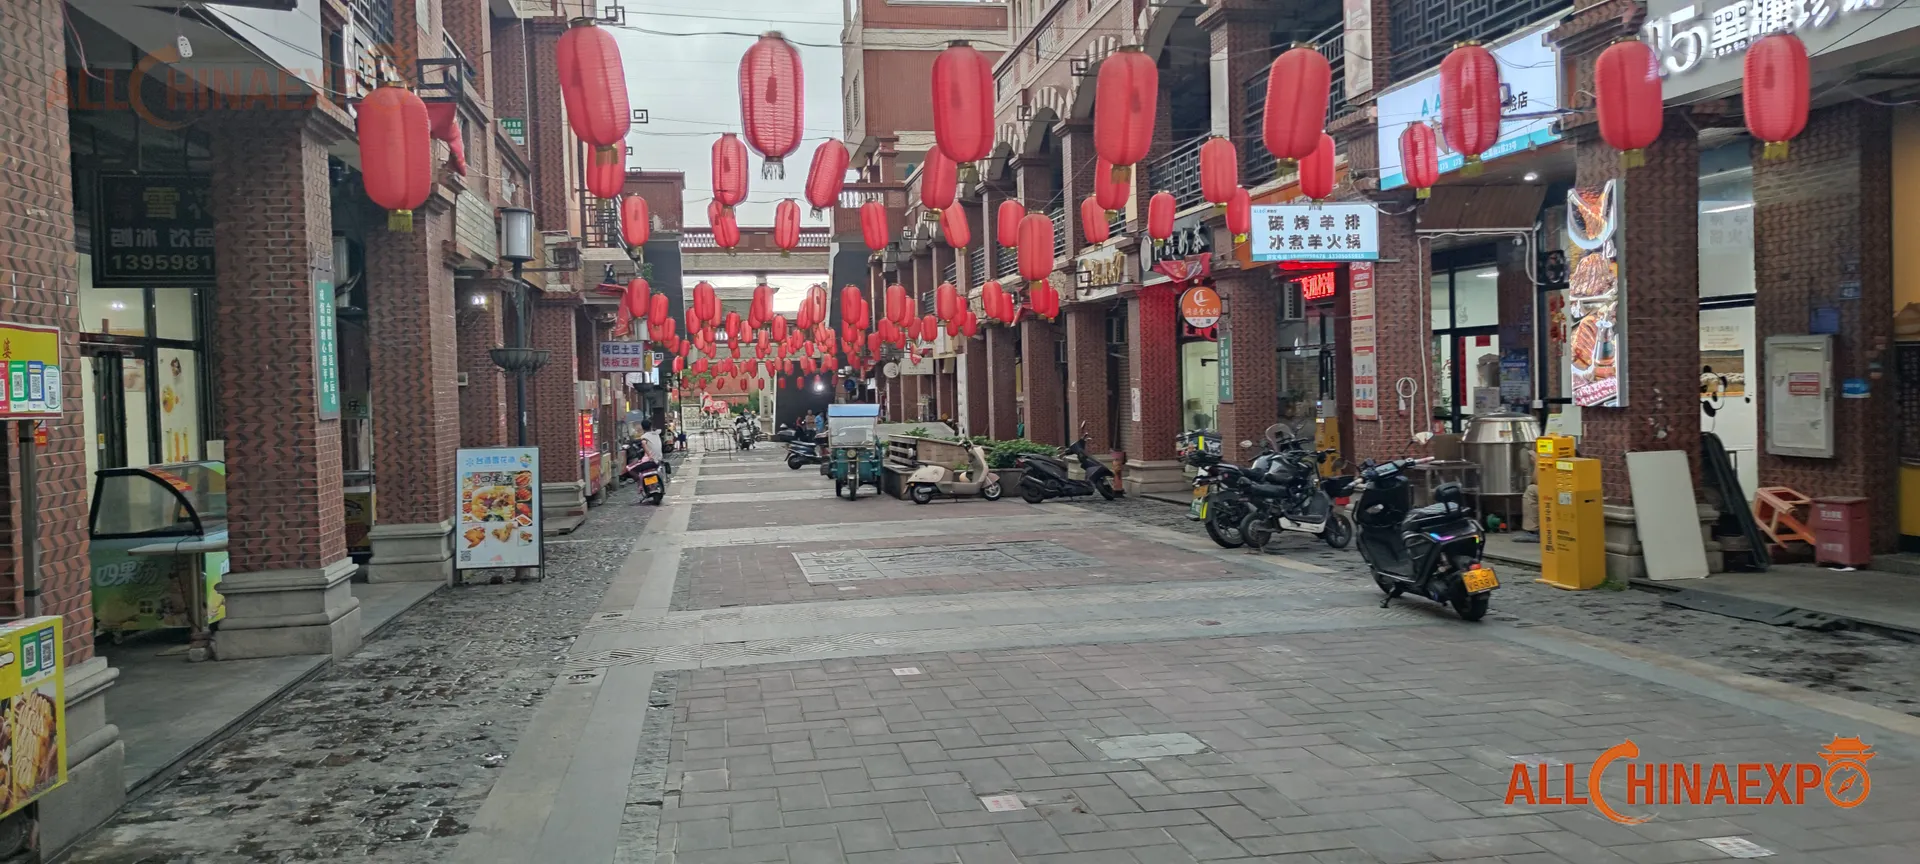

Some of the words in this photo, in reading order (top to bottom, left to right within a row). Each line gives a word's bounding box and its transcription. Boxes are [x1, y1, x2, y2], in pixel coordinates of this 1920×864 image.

[1268, 214, 1361, 231] 碳烤羊排
[1268, 234, 1361, 250] 冰煮羊火锅
